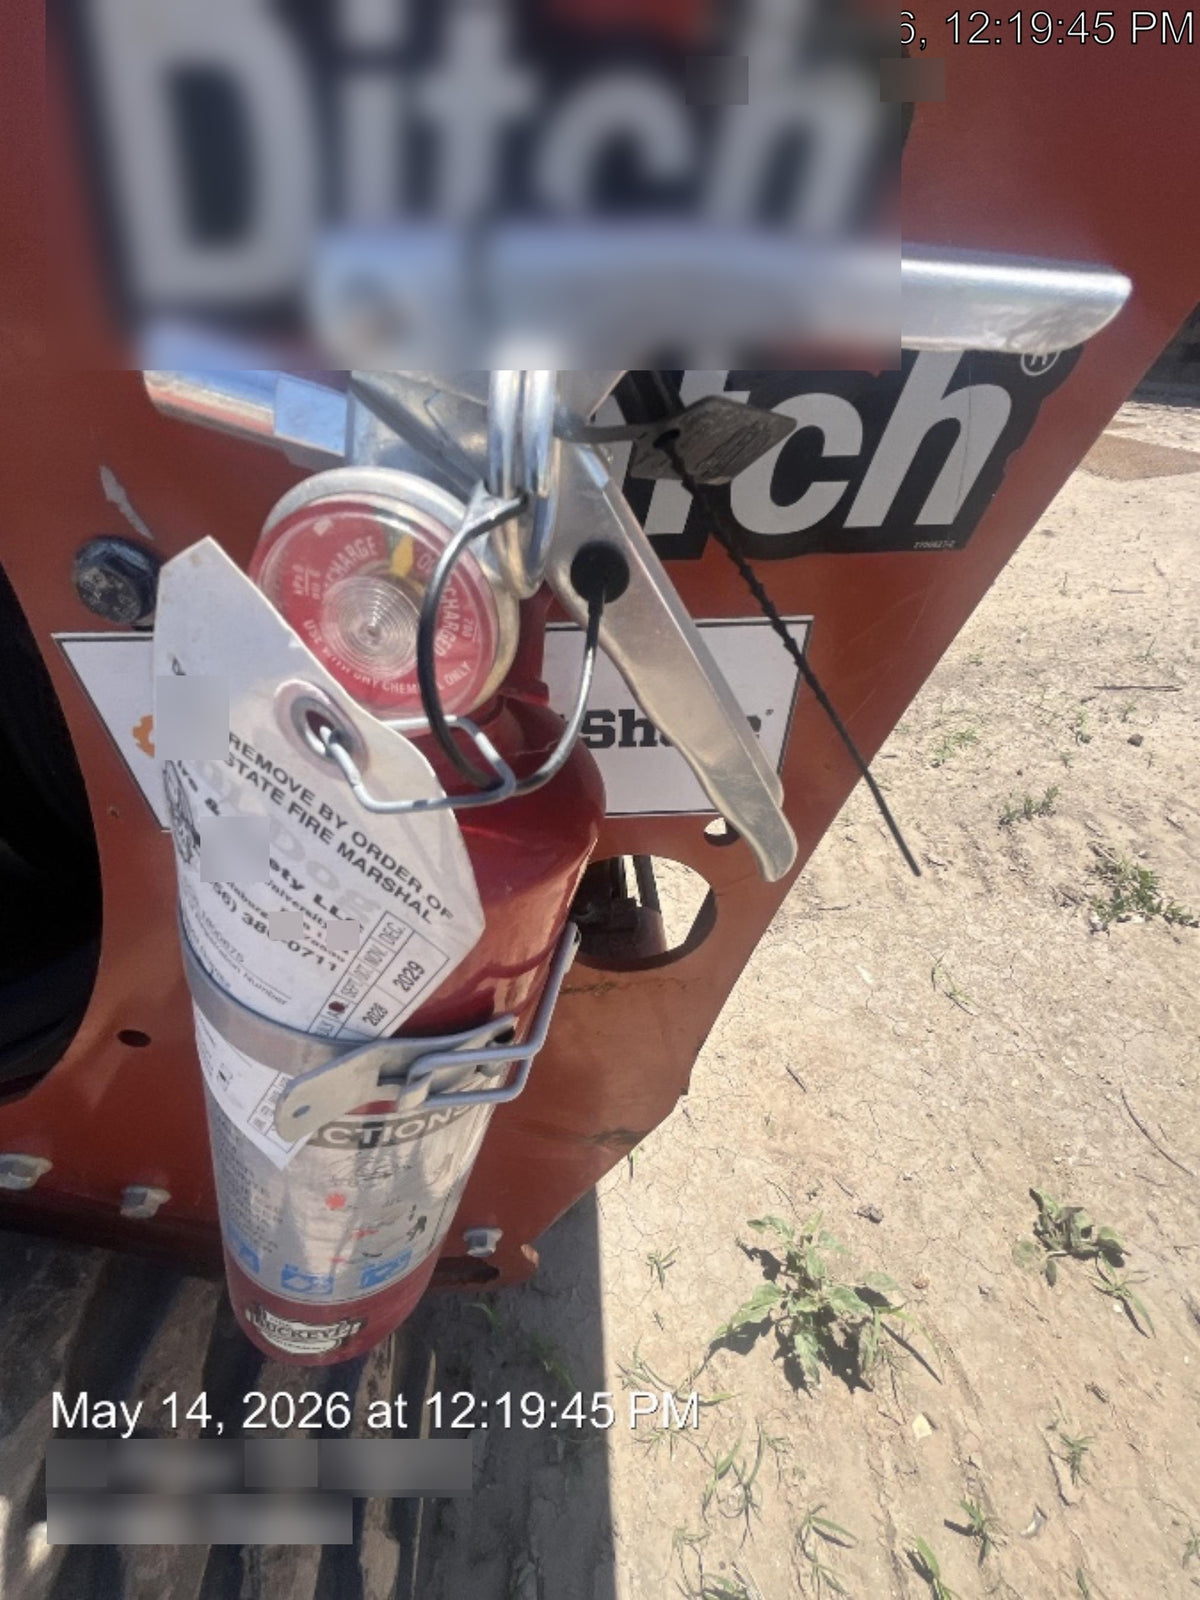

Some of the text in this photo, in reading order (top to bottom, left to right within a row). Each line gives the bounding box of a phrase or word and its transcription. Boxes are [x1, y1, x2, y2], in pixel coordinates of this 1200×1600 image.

[322, 536, 378, 588] CHARGE
[303, 619, 322, 644] USE
[382, 681, 444, 696] CHEML
[444, 660, 472, 686] ONLY
[225, 752, 285, 806] STATE
[287, 802, 336, 845] FIRE
[336, 842, 433, 925] MARSHAL
[229, 731, 454, 920] REMOVE BY ORDER OF
[392, 960, 425, 992] 2029
